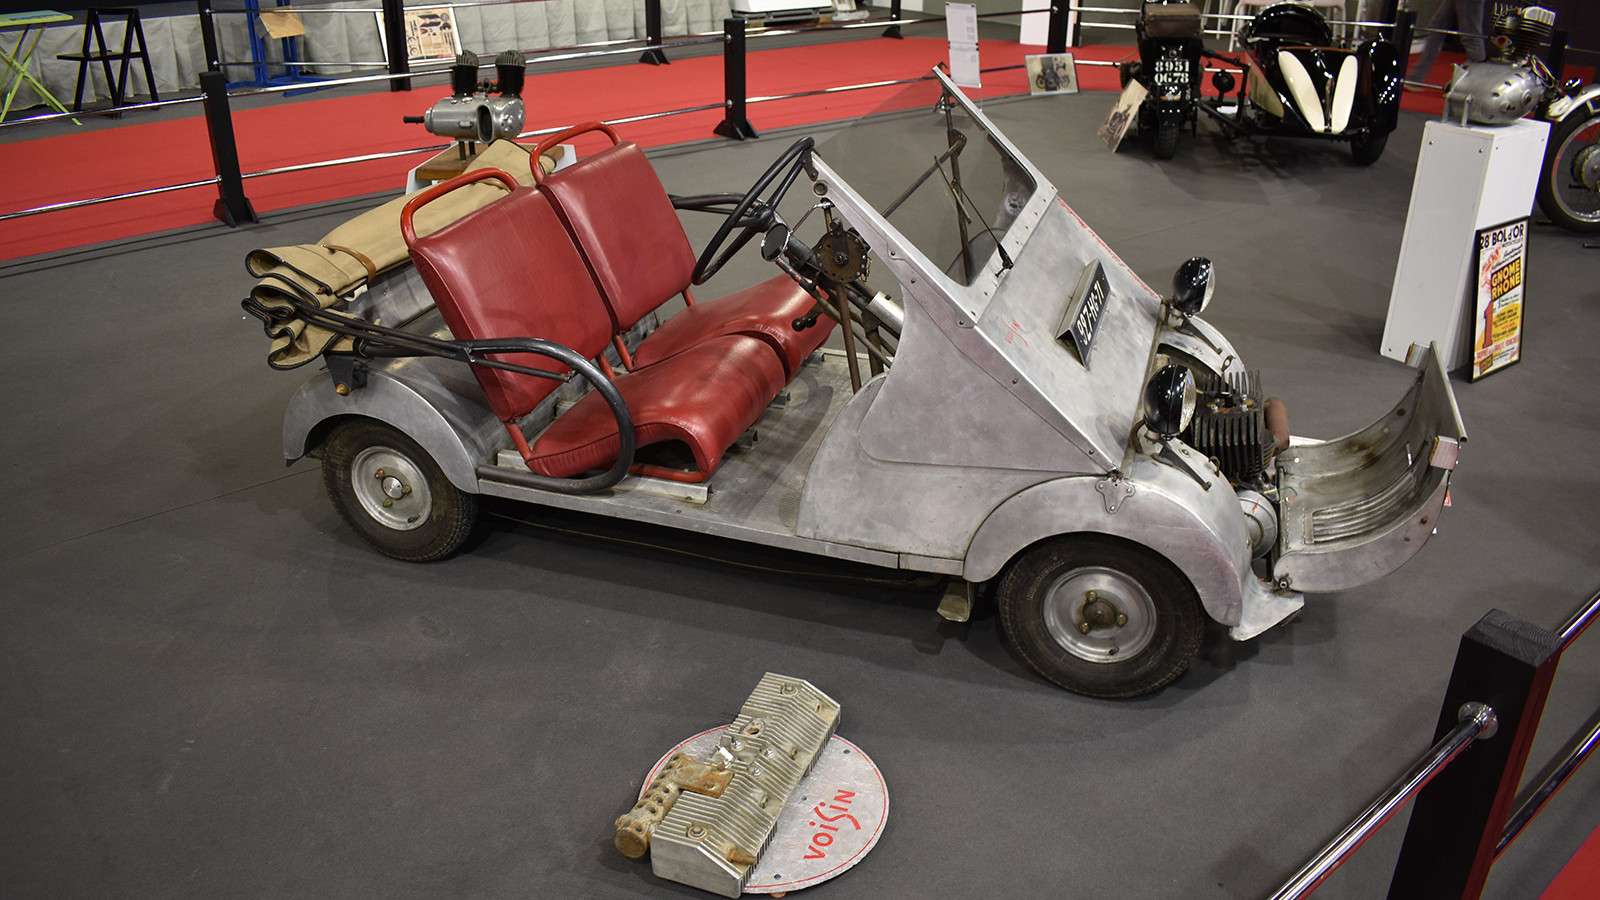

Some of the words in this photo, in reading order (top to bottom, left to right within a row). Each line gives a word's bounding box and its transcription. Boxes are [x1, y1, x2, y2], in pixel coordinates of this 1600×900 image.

[1155, 61, 1189, 72] 8951
[1154, 72, 1189, 86] QG78
[1492, 228, 1507, 246] BOL
[1491, 260, 1520, 287] GNOME
[1492, 272, 1520, 299] RHONE
